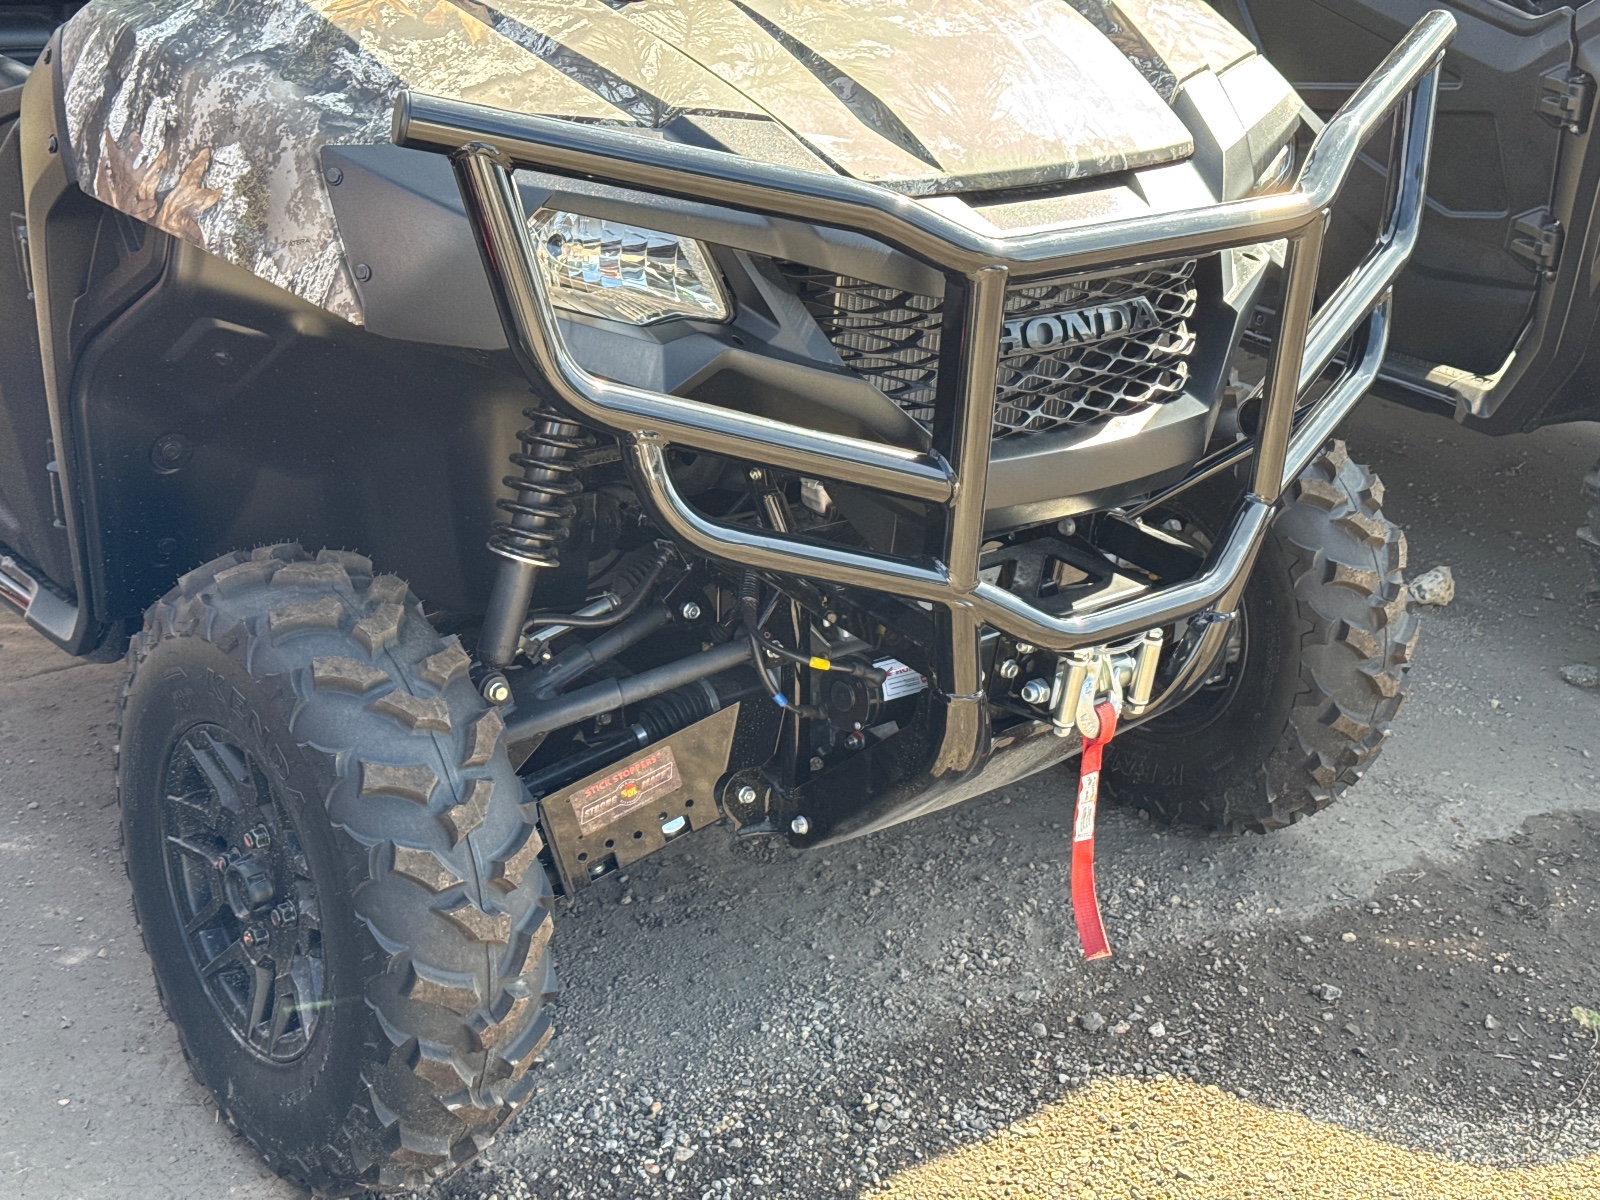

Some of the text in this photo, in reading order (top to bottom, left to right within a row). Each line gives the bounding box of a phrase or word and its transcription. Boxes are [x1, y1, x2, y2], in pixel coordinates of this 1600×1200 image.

[1001, 296, 1162, 355] HONDA
[585, 779, 612, 798] STICK
[612, 755, 657, 783] STOPPERS
